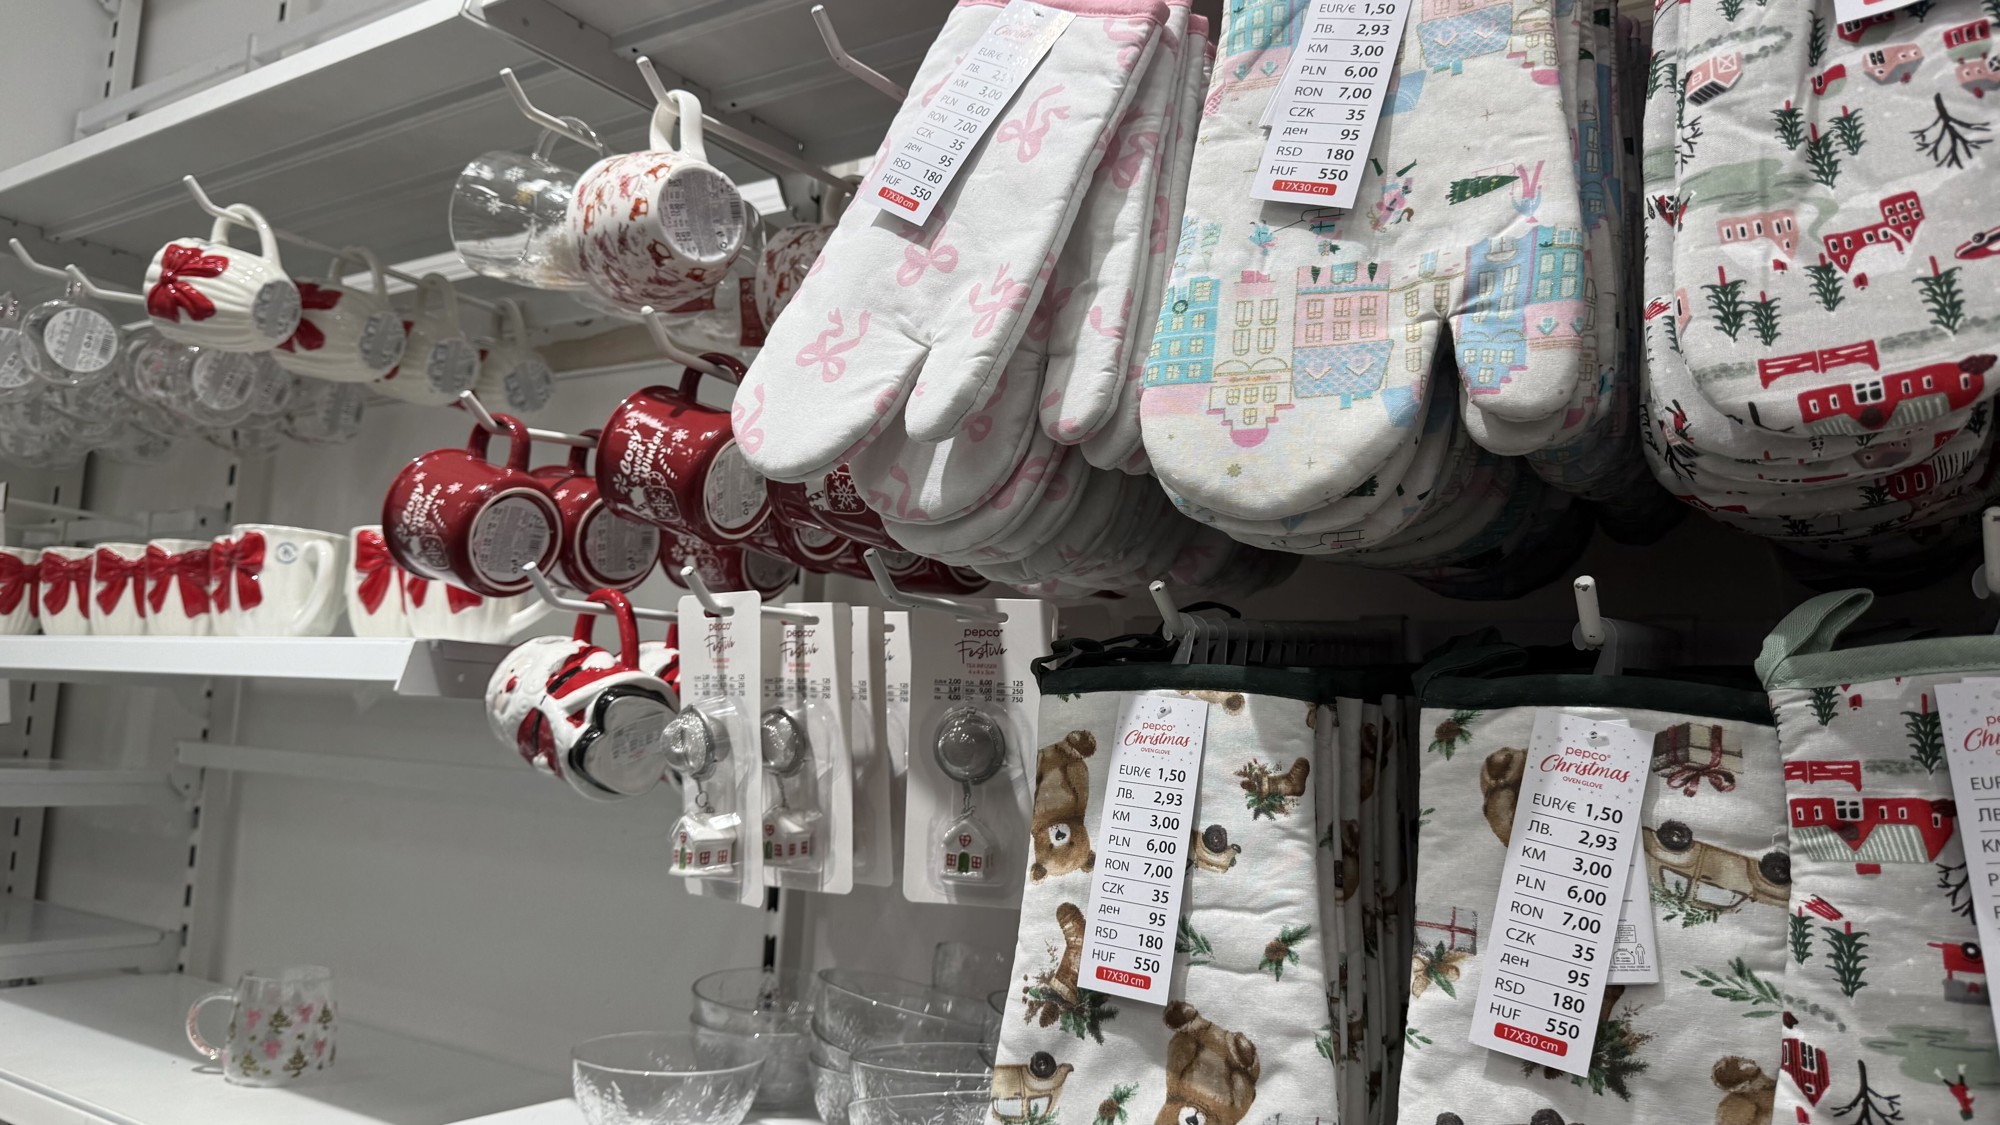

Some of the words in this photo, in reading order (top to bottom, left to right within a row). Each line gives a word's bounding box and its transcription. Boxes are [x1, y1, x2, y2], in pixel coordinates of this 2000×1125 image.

[1320, 4, 1356, 13] EUR/€
[1364, 3, 1395, 16] 1,50
[1356, 24, 1389, 36] 2,93
[1307, 44, 1328, 53] KM
[1350, 45, 1384, 57] 3,00
[1301, 65, 1326, 75] PLN
[1344, 66, 1378, 79] 6,00
[954, 79, 969, 88] KM
[979, 86, 1002, 100] 3,00
[1294, 86, 1323, 97] RON
[1338, 87, 1372, 100] 7,00
[941, 95, 958, 107] PLN
[966, 103, 990, 117] 6,00
[1289, 107, 1316, 117] CZK
[1346, 109, 1365, 120] 35
[928, 111, 948, 123] RON
[953, 119, 977, 134] 7,00
[1283, 127, 1308, 135] ден
[1340, 129, 1360, 140] 95
[916, 127, 934, 139] CZK
[950, 139, 965, 151] 35
[904, 142, 922, 153] ден
[938, 155, 954, 167] 95
[1276, 146, 1303, 156] RSD
[1326, 149, 1354, 160] 180
[893, 157, 911, 170] RSD
[923, 169, 942, 184] 180
[1270, 165, 1298, 175] HUF
[1318, 168, 1348, 181] 550
[882, 173, 902, 186] HUF
[911, 186, 932, 201] 550
[1280, 182, 1312, 192] 17X30
[1313, 185, 1328, 193] cm
[884, 189, 903, 202] 17X30
[902, 199, 914, 209] cm
[620, 430, 642, 475] Cosy
[640, 430, 664, 480] Winter
[786, 630, 812, 638] pepco
[964, 628, 1000, 638] pepco
[954, 640, 1008, 664] Festive
[1142, 722, 1173, 731] pepco
[1124, 730, 1190, 747] Christmas
[1565, 746, 1607, 761] pepco
[1120, 764, 1151, 778] EUR/€
[1158, 767, 1186, 783] 1,50
[1540, 754, 1630, 782] Christmas
[1563, 776, 1580, 784] OVEN
[1582, 781, 1603, 789] GLOVE
[1970, 776, 2000, 790] EUR
[1116, 788, 1135, 800] ЛВ.
[1153, 791, 1183, 807] 2,93
[1532, 793, 1576, 813] EUR/€
[1586, 804, 1623, 823] 1,50
[1112, 810, 1130, 822] KM
[1150, 814, 1180, 831] 3,00
[1108, 834, 1131, 848] PLN
[1146, 838, 1176, 855] 6,00
[1528, 819, 1552, 836] ЛВ.
[1578, 830, 1617, 851] 2,93
[1105, 858, 1130, 872] RON
[1143, 862, 1173, 880] 7,00
[1522, 846, 1546, 861] KM
[1572, 858, 1612, 879] 3,00
[1102, 881, 1124, 895] CZK
[1152, 889, 1169, 904] 35
[1516, 874, 1546, 891] PLN
[1567, 885, 1607, 907] 6,00
[1098, 904, 1120, 916] ден
[1149, 912, 1166, 927] 95
[1510, 901, 1544, 920] RON
[1562, 912, 1601, 934] 7,00
[1095, 926, 1118, 940] RSD
[1138, 933, 1163, 950] 180
[1506, 928, 1536, 945] CZK
[1572, 943, 1595, 962] 35
[1092, 949, 1116, 963] HUF
[1134, 956, 1160, 974] 550
[1500, 952, 1529, 968] ден
[1567, 969, 1590, 988] 95
[1102, 969, 1129, 984] 17X30
[1131, 977, 1144, 987] cm
[1495, 977, 1525, 995] RSD
[1552, 992, 1585, 1014] 180
[1489, 1002, 1521, 1020] HUF
[1545, 1018, 1580, 1040] 550
[1503, 1026, 1538, 1046] 17X30
[1541, 1039, 1558, 1052] cm
